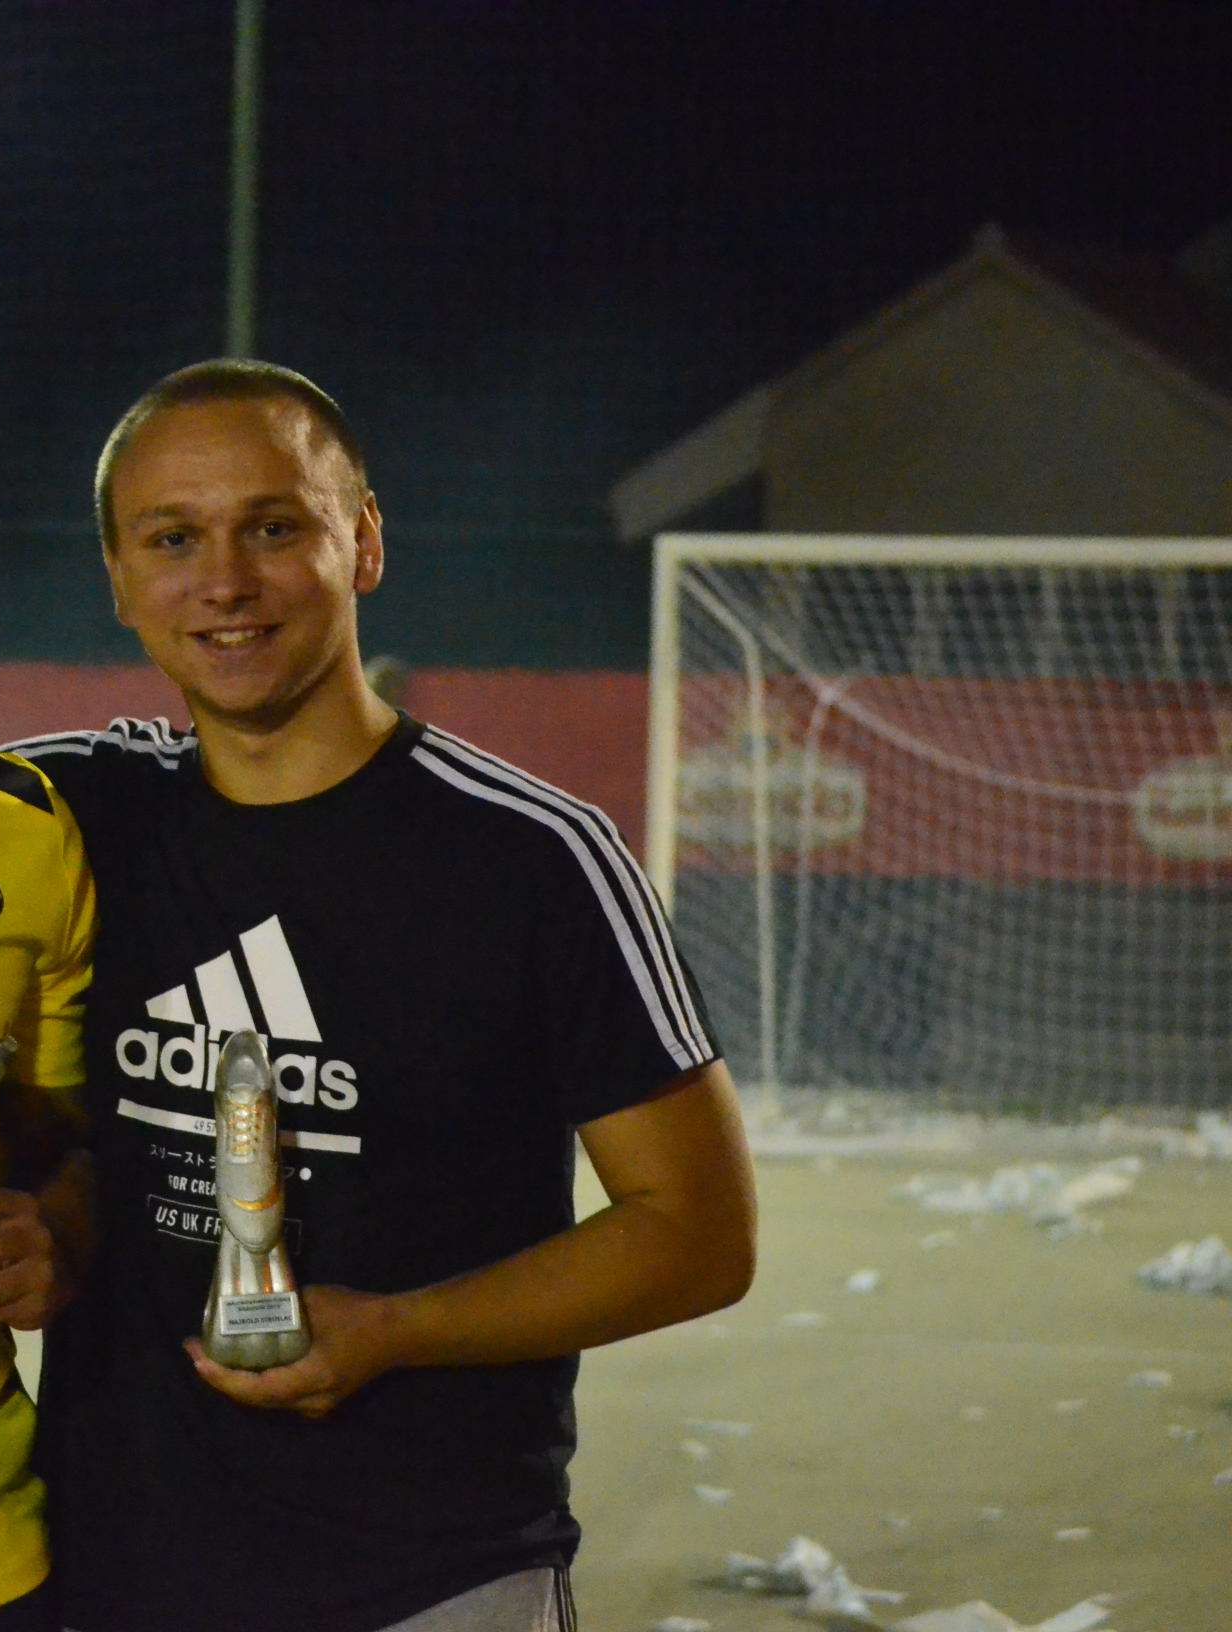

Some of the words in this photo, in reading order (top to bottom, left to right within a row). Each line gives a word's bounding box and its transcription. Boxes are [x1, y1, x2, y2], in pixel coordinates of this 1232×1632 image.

[115, 1023, 359, 1110] adias
[168, 1174, 188, 1191] FOR
[191, 1178, 217, 1197] CREA
[156, 1205, 179, 1227] US
[182, 1212, 199, 1232] UK
